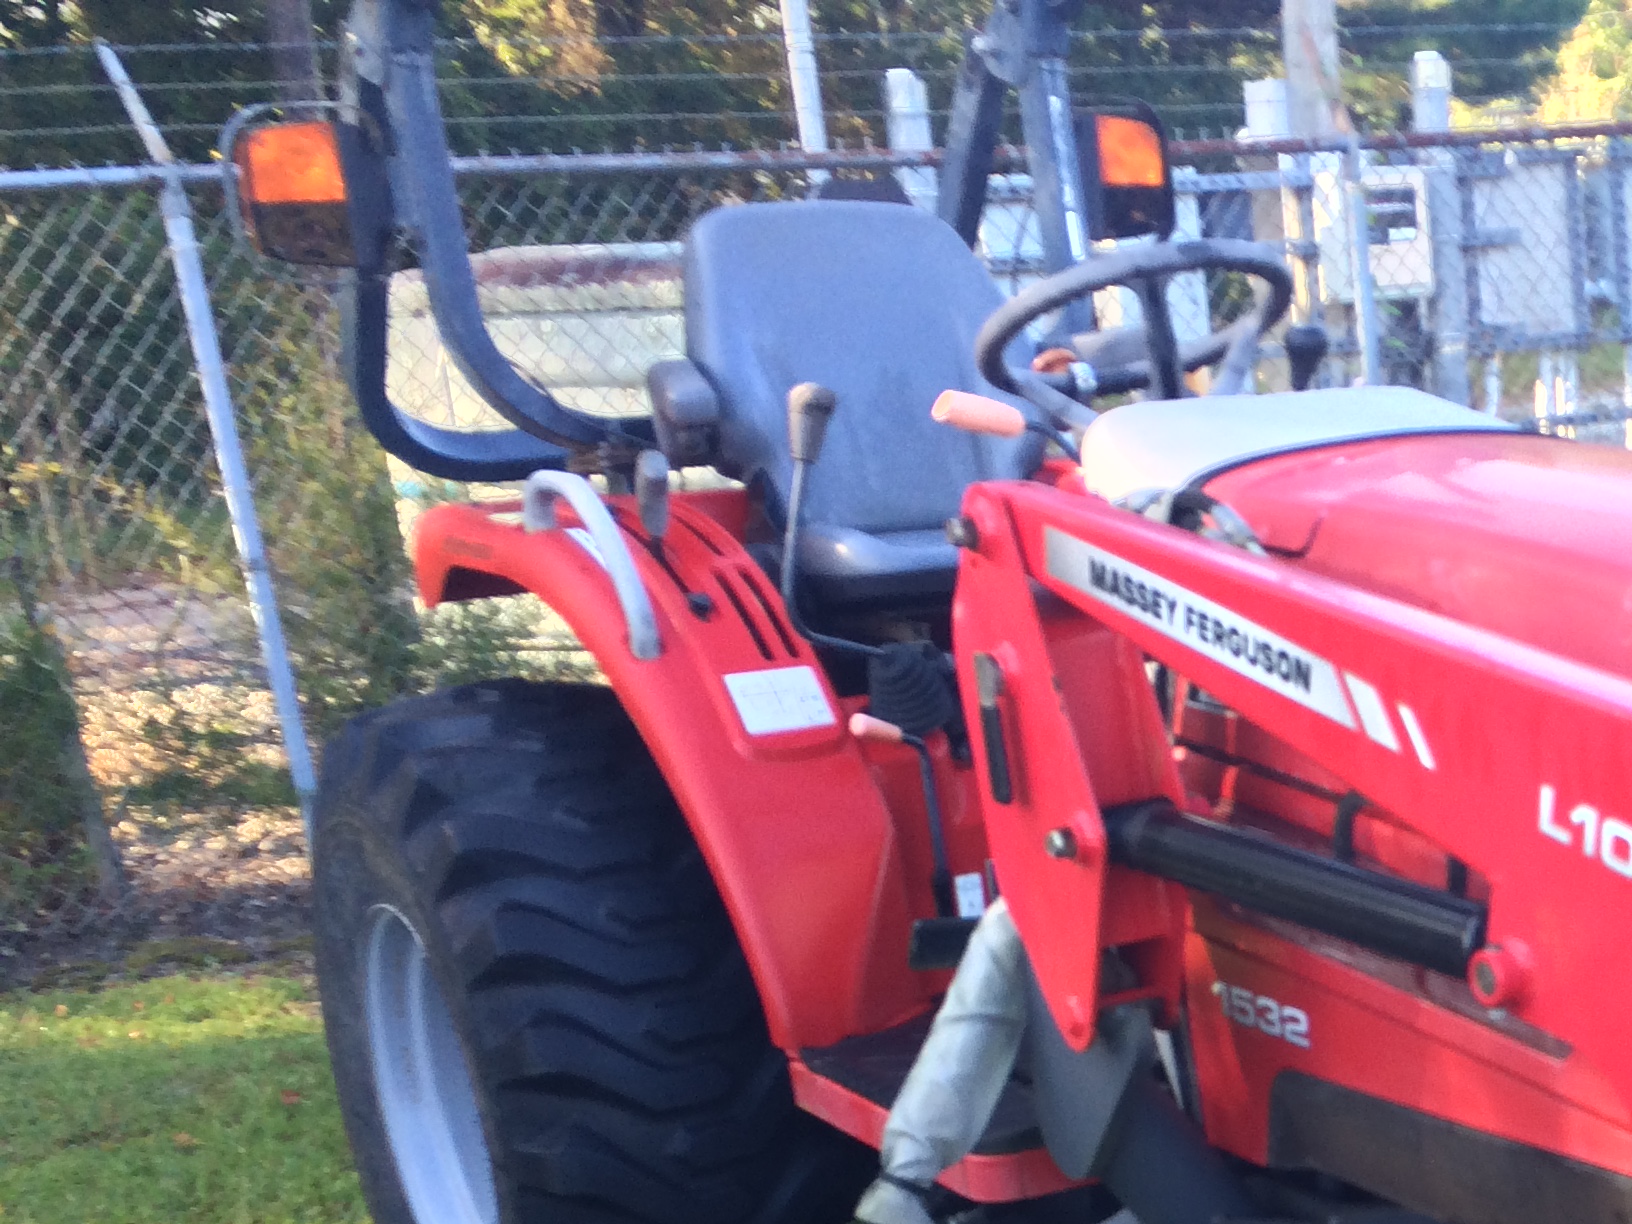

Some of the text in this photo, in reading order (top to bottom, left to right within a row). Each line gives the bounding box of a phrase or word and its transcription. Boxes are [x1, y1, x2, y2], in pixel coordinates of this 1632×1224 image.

[1089, 556, 1312, 694] MASSEY FERGUSON
[1211, 980, 1311, 1048] 1532
